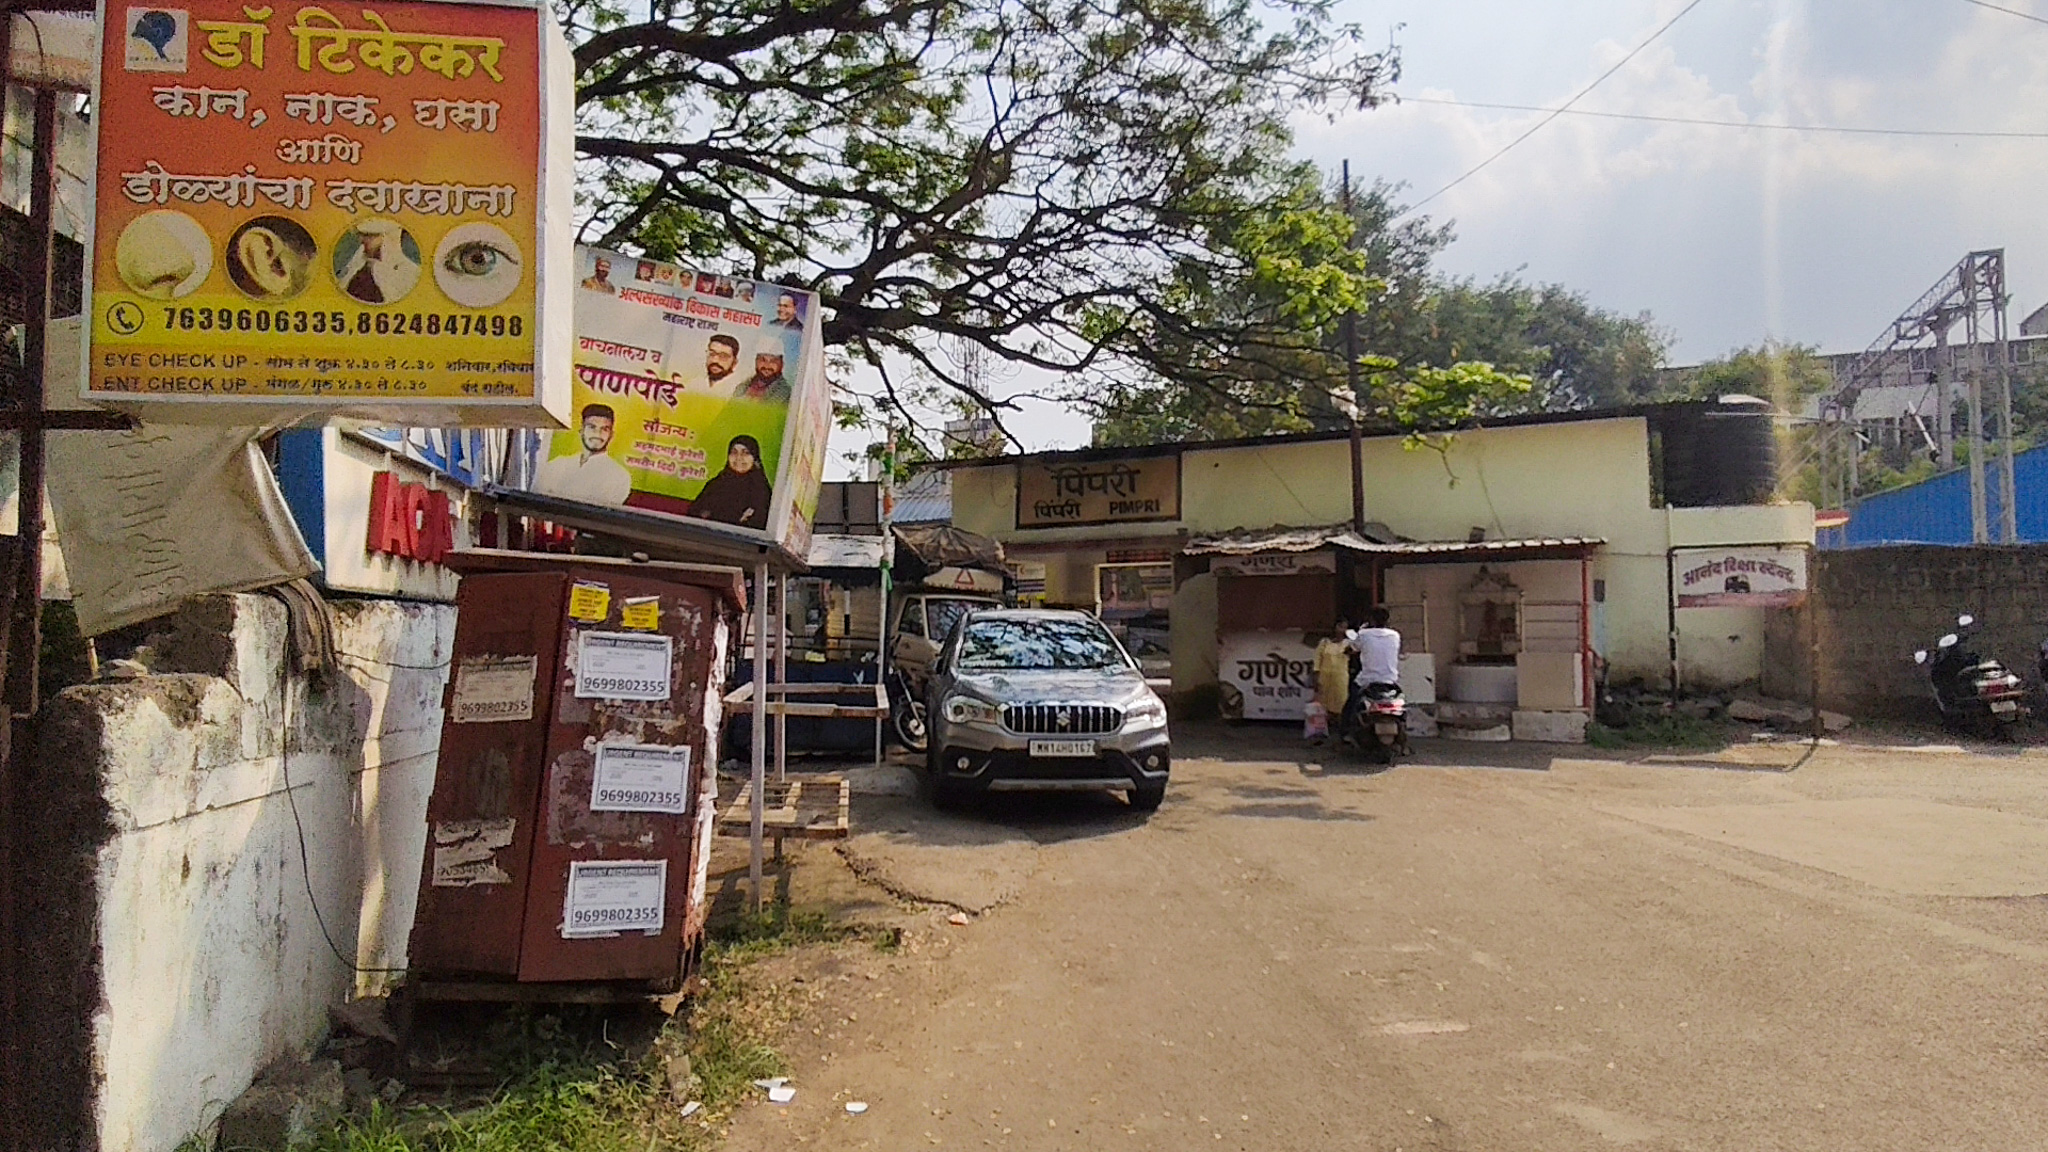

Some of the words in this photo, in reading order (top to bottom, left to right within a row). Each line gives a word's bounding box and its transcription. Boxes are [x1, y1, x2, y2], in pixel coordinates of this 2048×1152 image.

[197, 5, 272, 69] डॉ
[290, 7, 506, 83] टिकेकर
[152, 85, 269, 128] कान,
[284, 91, 397, 134] नाक,
[413, 98, 502, 133] घसा
[276, 134, 363, 165] आणि
[121, 159, 317, 210] डोळ्यांचा
[325, 178, 517, 217] दवाखाना
[104, 353, 142, 368] EYE
[149, 353, 216, 369] CHECK
[222, 353, 248, 369] UP
[104, 376, 141, 391] ENT
[148, 375, 215, 391] CHECK
[222, 376, 248, 391] UP
[1046, 463, 1140, 497] पिंपरी
[1034, 499, 1081, 520] पिंपरी
[1109, 499, 1161, 515] PIMPRI
[1683, 559, 1723, 587] आनंद
[1723, 556, 1757, 574] रिक्षा
[583, 677, 665, 692] 9699802355
[461, 701, 528, 713] 9699802355
[600, 789, 681, 804] 9699802355
[574, 907, 658, 922] 9699802355
